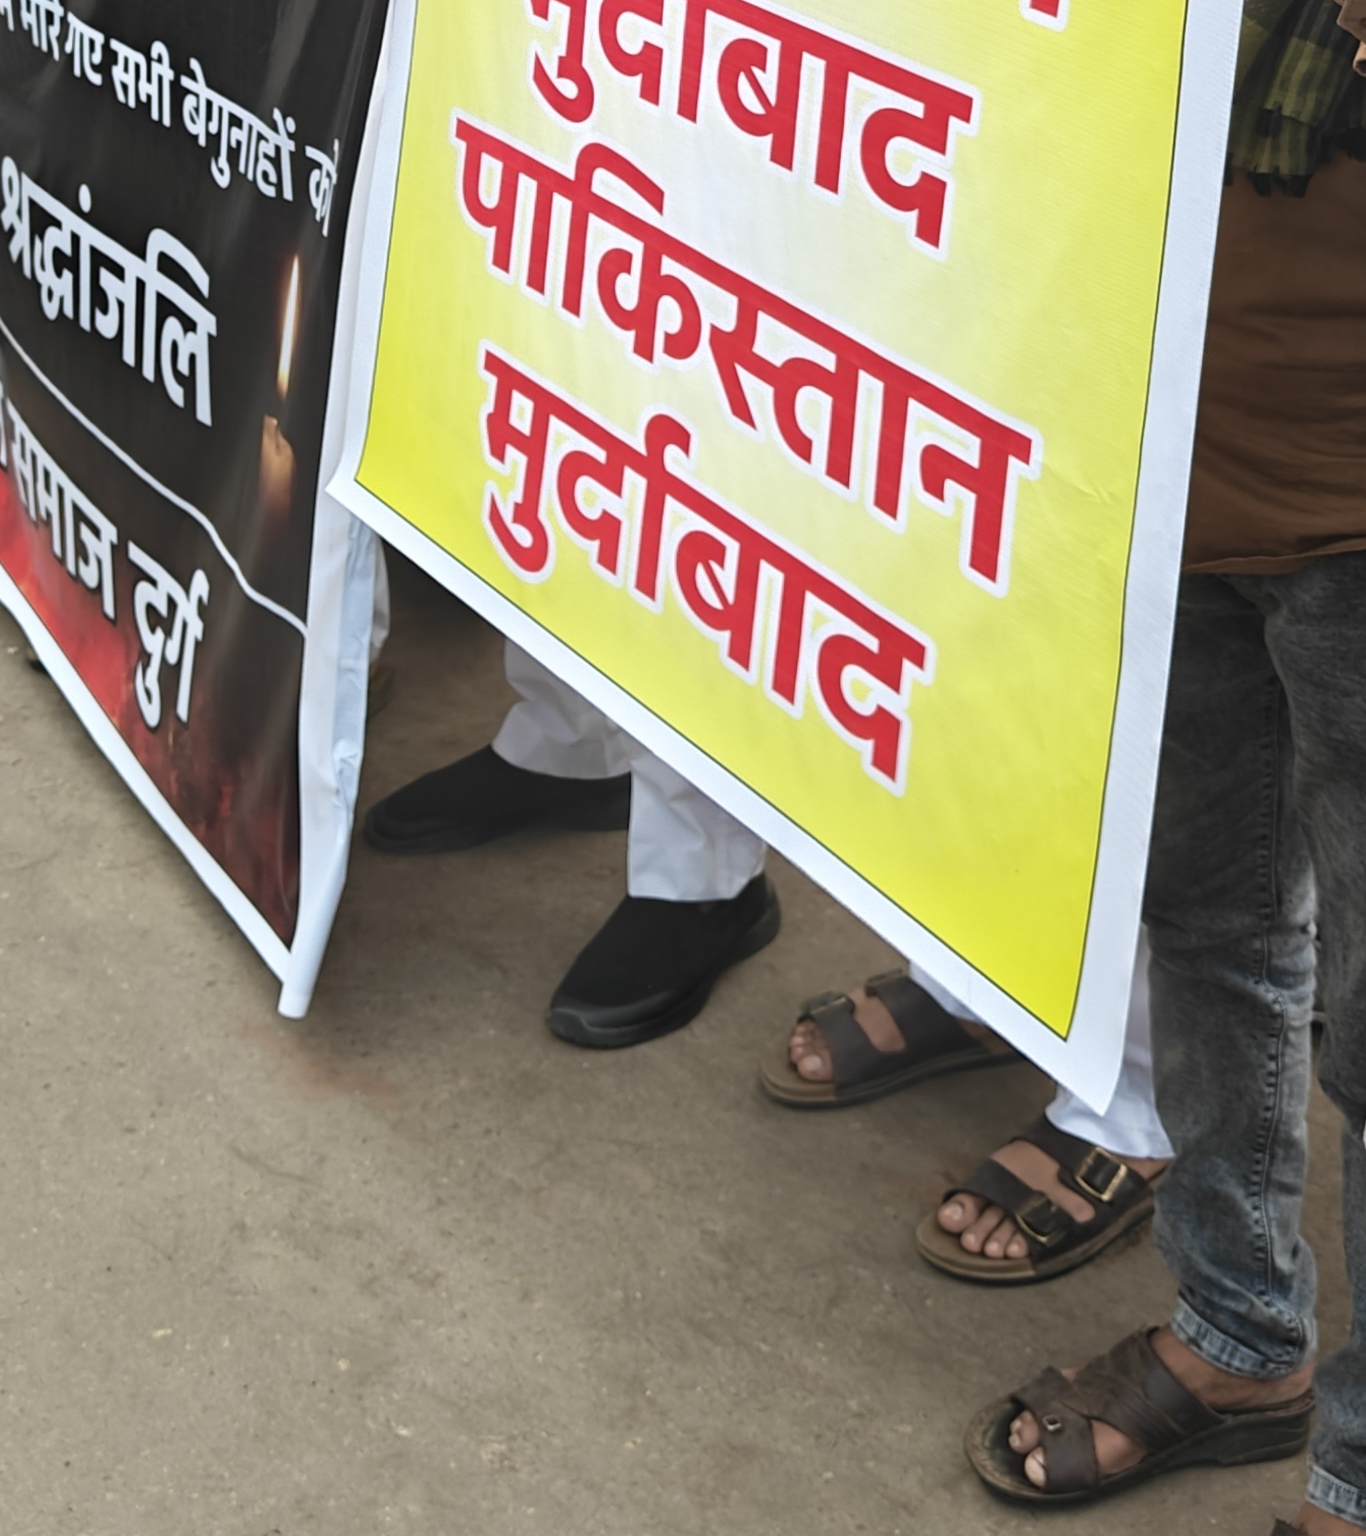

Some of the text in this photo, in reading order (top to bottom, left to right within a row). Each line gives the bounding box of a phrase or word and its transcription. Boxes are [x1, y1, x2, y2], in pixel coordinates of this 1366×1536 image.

[64, 11, 105, 86] गए
[110, 39, 174, 127] सभी
[180, 57, 296, 202] बेगुनाहों
[0, 156, 217, 427] श्रद्धांजलि
[456, 119, 1032, 582] पाकिस्तान
[6, 398, 118, 620] समाज
[128, 539, 210, 728] दुर्ग
[484, 351, 926, 780] मुर्दाबाद
